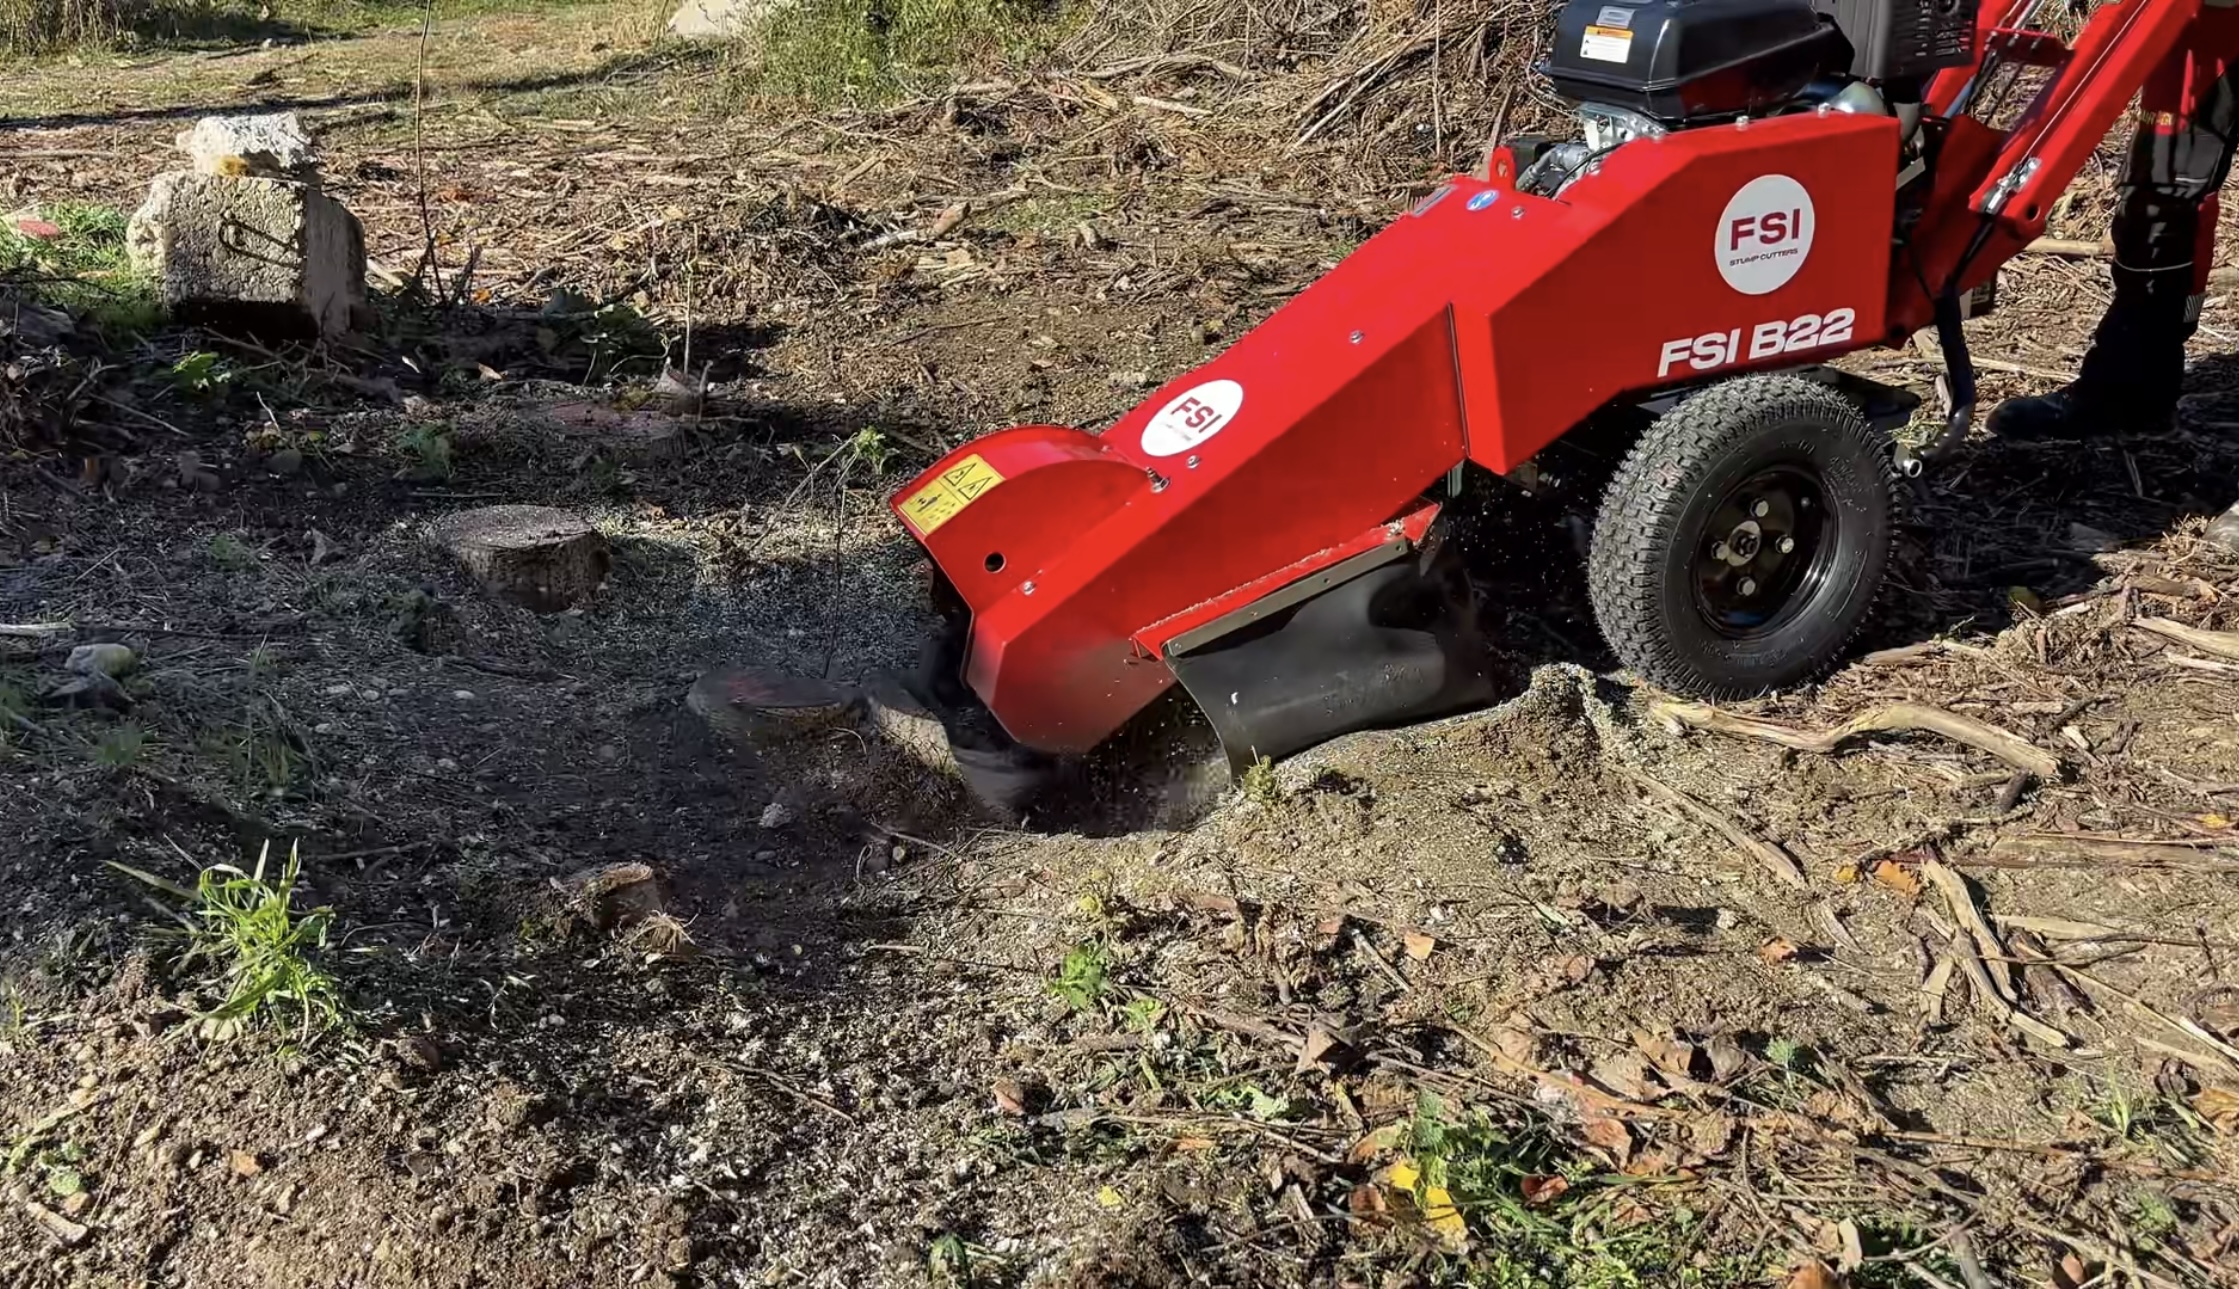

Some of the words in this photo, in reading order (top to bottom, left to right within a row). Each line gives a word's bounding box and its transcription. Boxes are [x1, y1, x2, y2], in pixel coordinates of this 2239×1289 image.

[1730, 208, 1801, 251] FSI
[1729, 254, 1760, 267] STUMP
[1760, 247, 1799, 261] CUTTERS
[1657, 327, 1741, 378] FSI
[1748, 307, 1856, 360] B22
[1170, 396, 1223, 433] FSI
